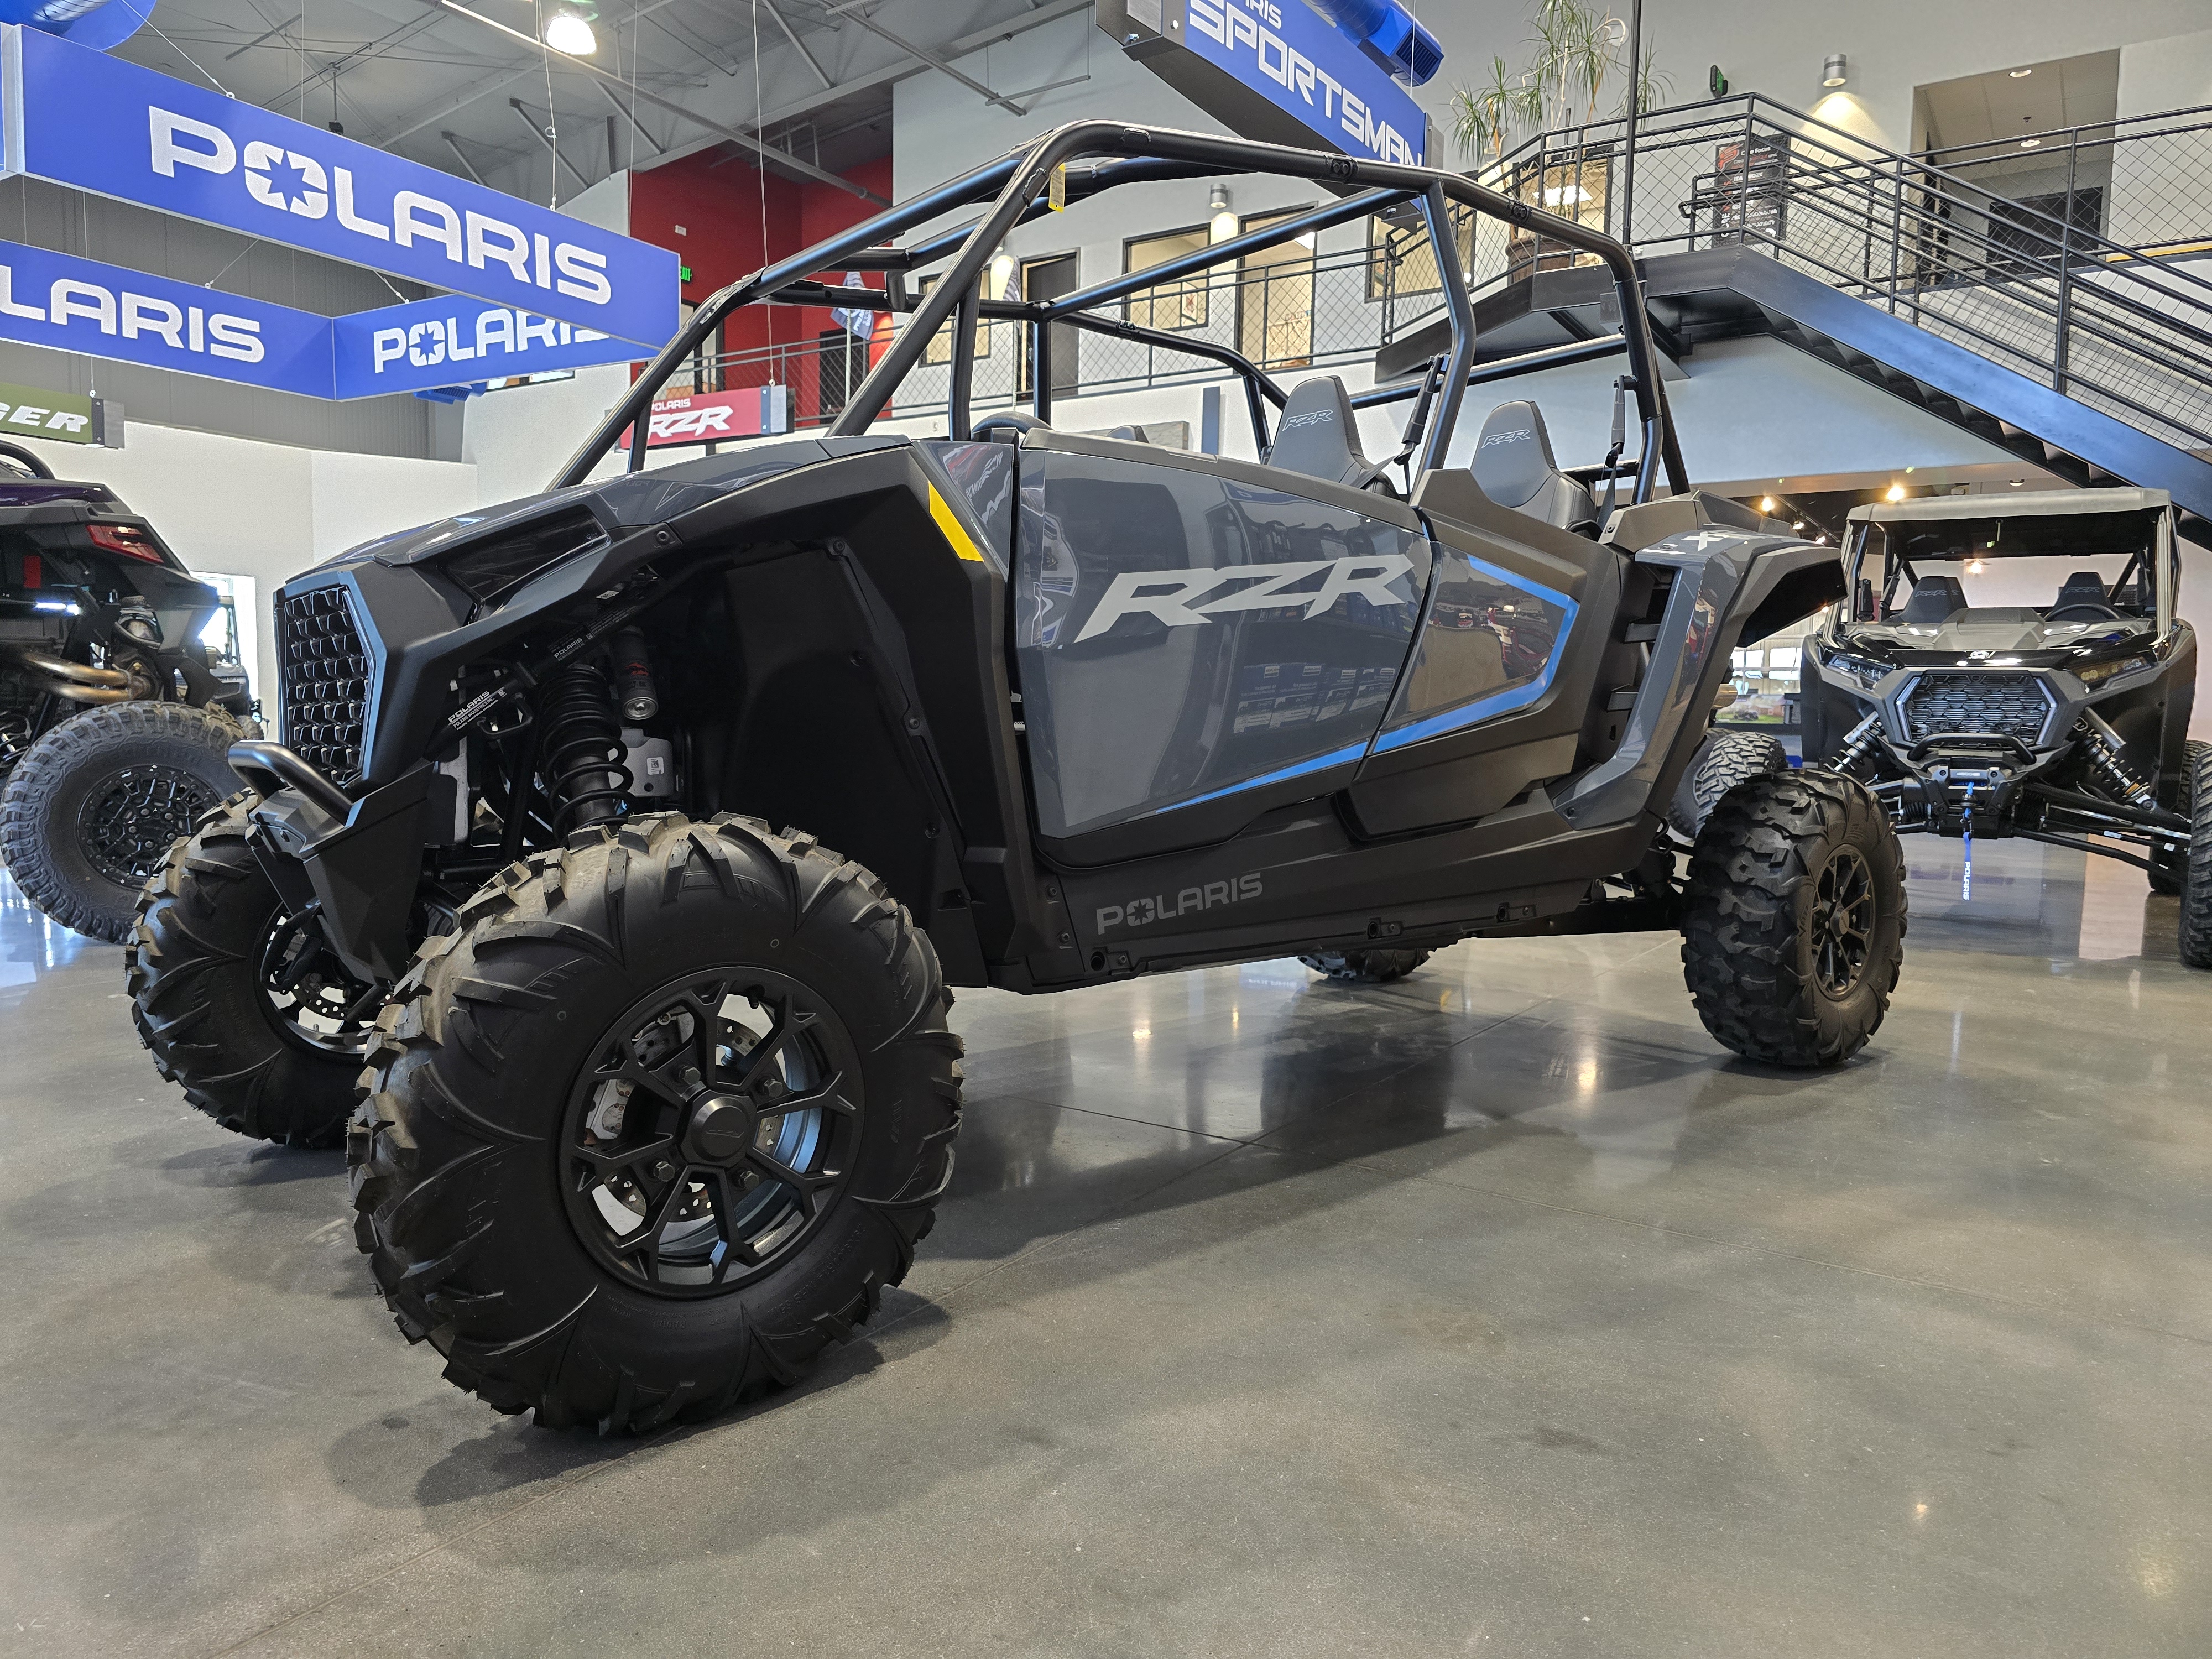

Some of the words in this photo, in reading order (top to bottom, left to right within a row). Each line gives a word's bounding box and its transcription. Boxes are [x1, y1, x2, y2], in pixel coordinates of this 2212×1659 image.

[1245, 0, 1281, 29] RIS
[148, 105, 612, 305] POLARIS
[0, 402, 88, 432] ER
[648, 405, 733, 440] RZR
[1282, 409, 1333, 431] RZR
[1481, 429, 1531, 448] RZR
[1073, 554, 1415, 644] RZR
[554, 638, 583, 658] POLARIS
[447, 691, 490, 723] POLARIS
[1096, 872, 1264, 935] POLARIS
